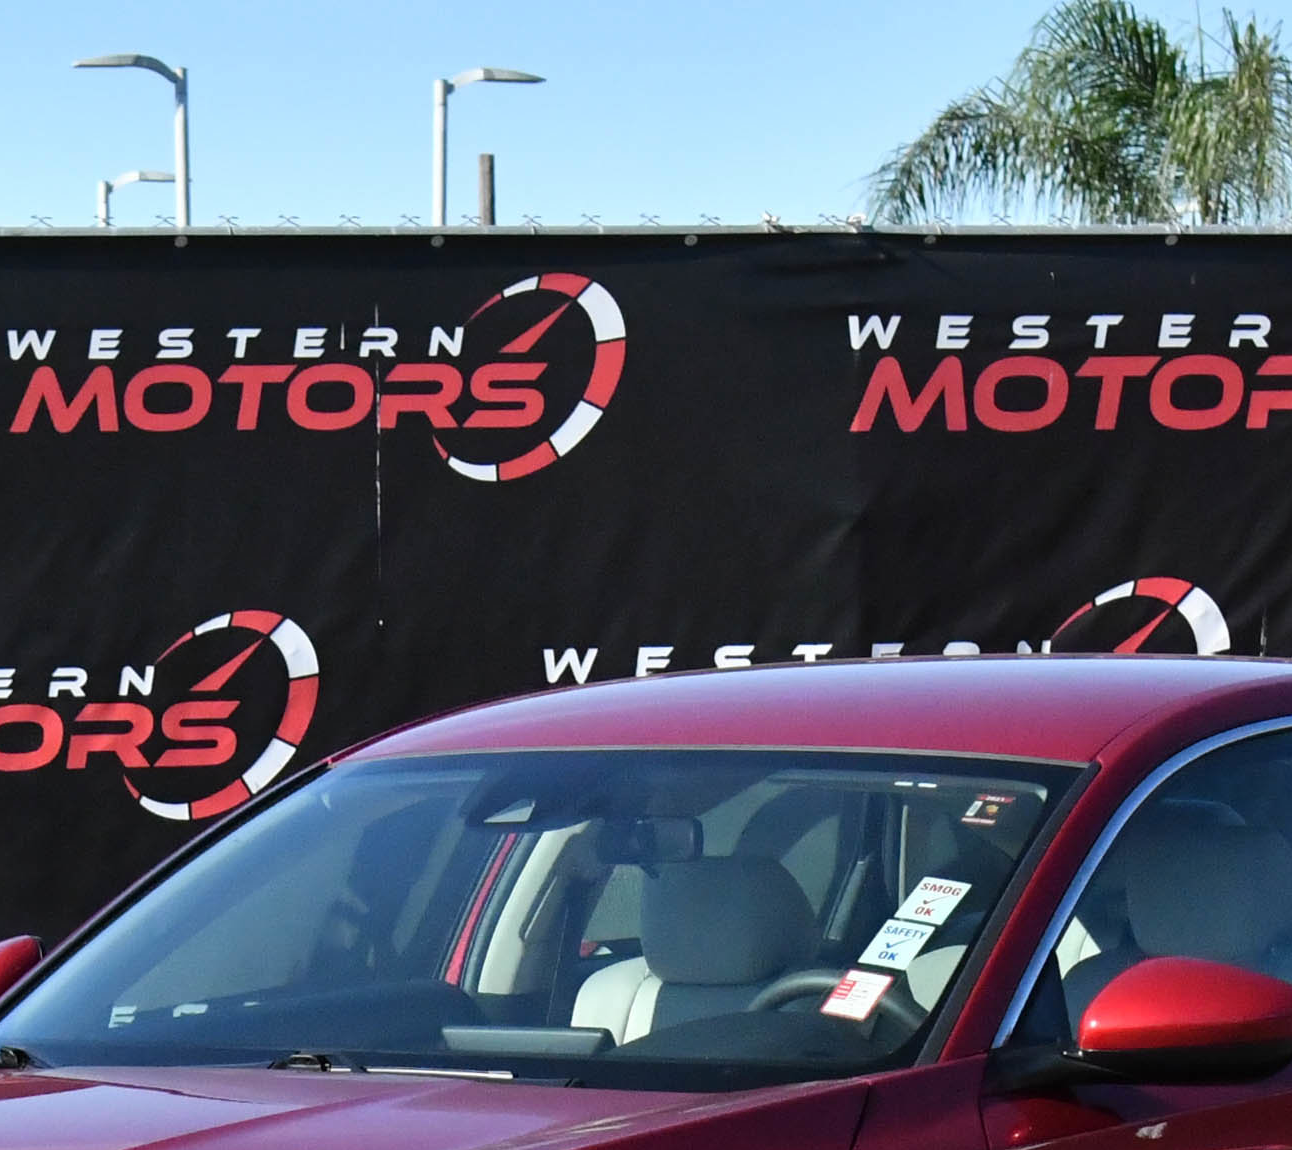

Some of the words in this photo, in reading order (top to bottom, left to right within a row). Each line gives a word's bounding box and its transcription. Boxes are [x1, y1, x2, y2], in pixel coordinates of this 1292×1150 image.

[7, 327, 464, 360] WESTERN
[10, 363, 548, 433] MOTORS
[920, 882, 963, 897] SMOG
[914, 906, 936, 917] OK
[883, 925, 930, 939] SAFETY
[877, 950, 899, 962] OK
